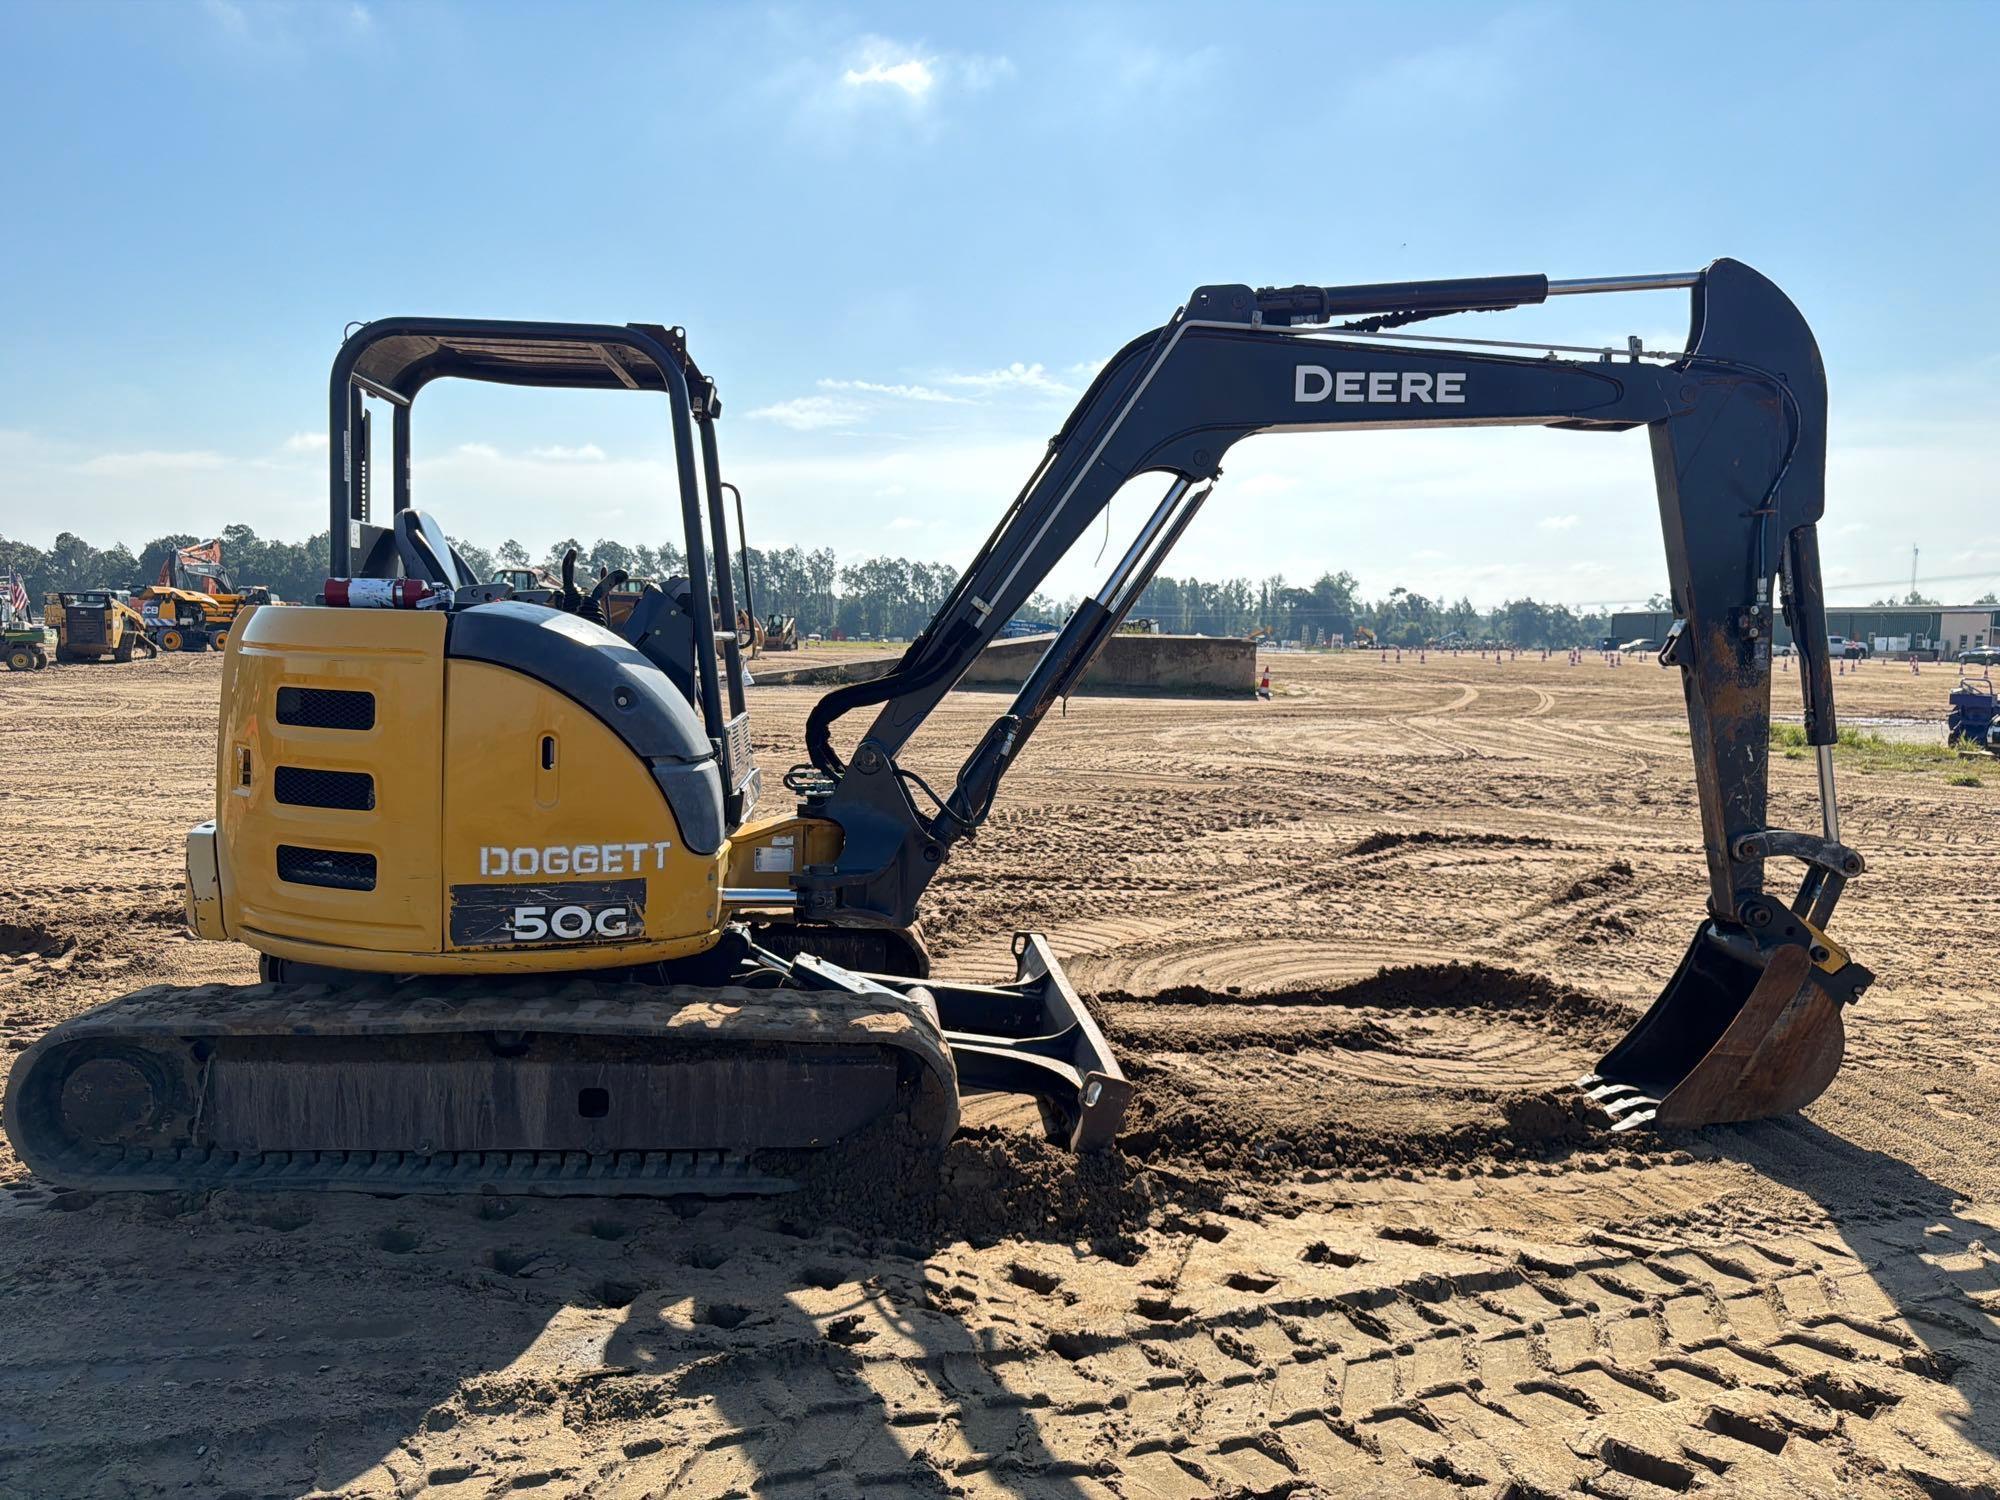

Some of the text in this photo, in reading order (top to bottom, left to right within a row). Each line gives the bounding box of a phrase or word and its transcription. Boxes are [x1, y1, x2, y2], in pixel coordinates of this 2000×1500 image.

[1294, 364, 1467, 403] DEERE
[480, 841, 671, 875] DOGGETT
[513, 905, 627, 940] 50G
